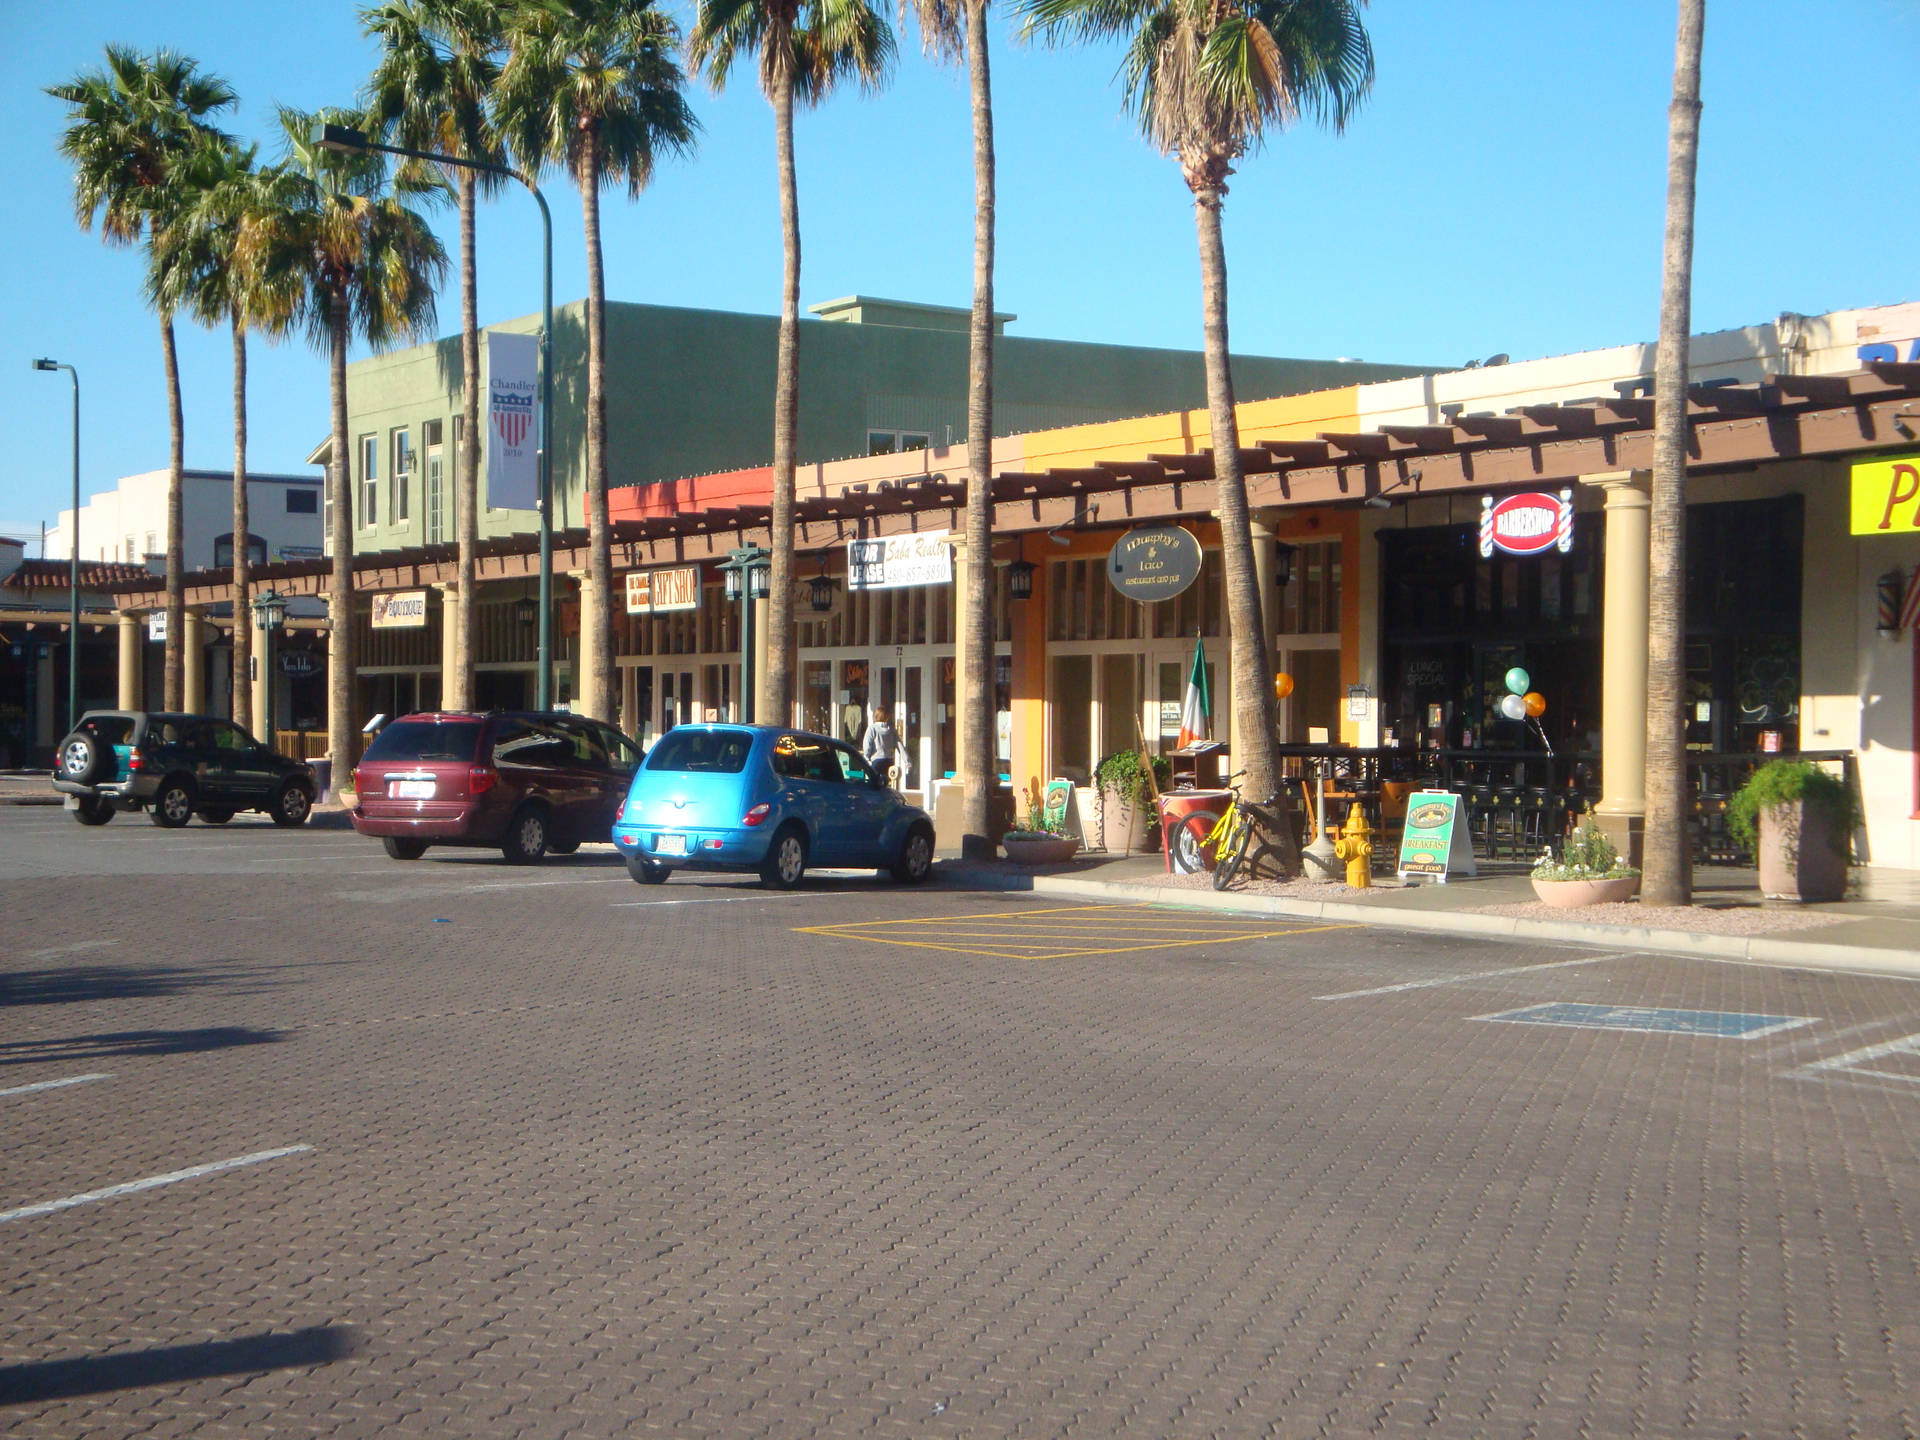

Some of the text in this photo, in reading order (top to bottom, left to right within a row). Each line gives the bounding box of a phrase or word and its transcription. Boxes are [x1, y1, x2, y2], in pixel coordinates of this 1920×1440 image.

[491, 379, 536, 391] Chandler
[503, 448, 522, 457] 2010
[1496, 507, 1556, 538] BARBERSHOP
[886, 537, 946, 562] Saba Realty
[1126, 533, 1180, 552] Murphy's
[854, 543, 879, 563] FOR
[850, 563, 884, 583] LEASE
[653, 571, 673, 607] GIFT
[388, 600, 424, 618] BOUTIQUE
[1405, 839, 1448, 850] BREAKFAST
